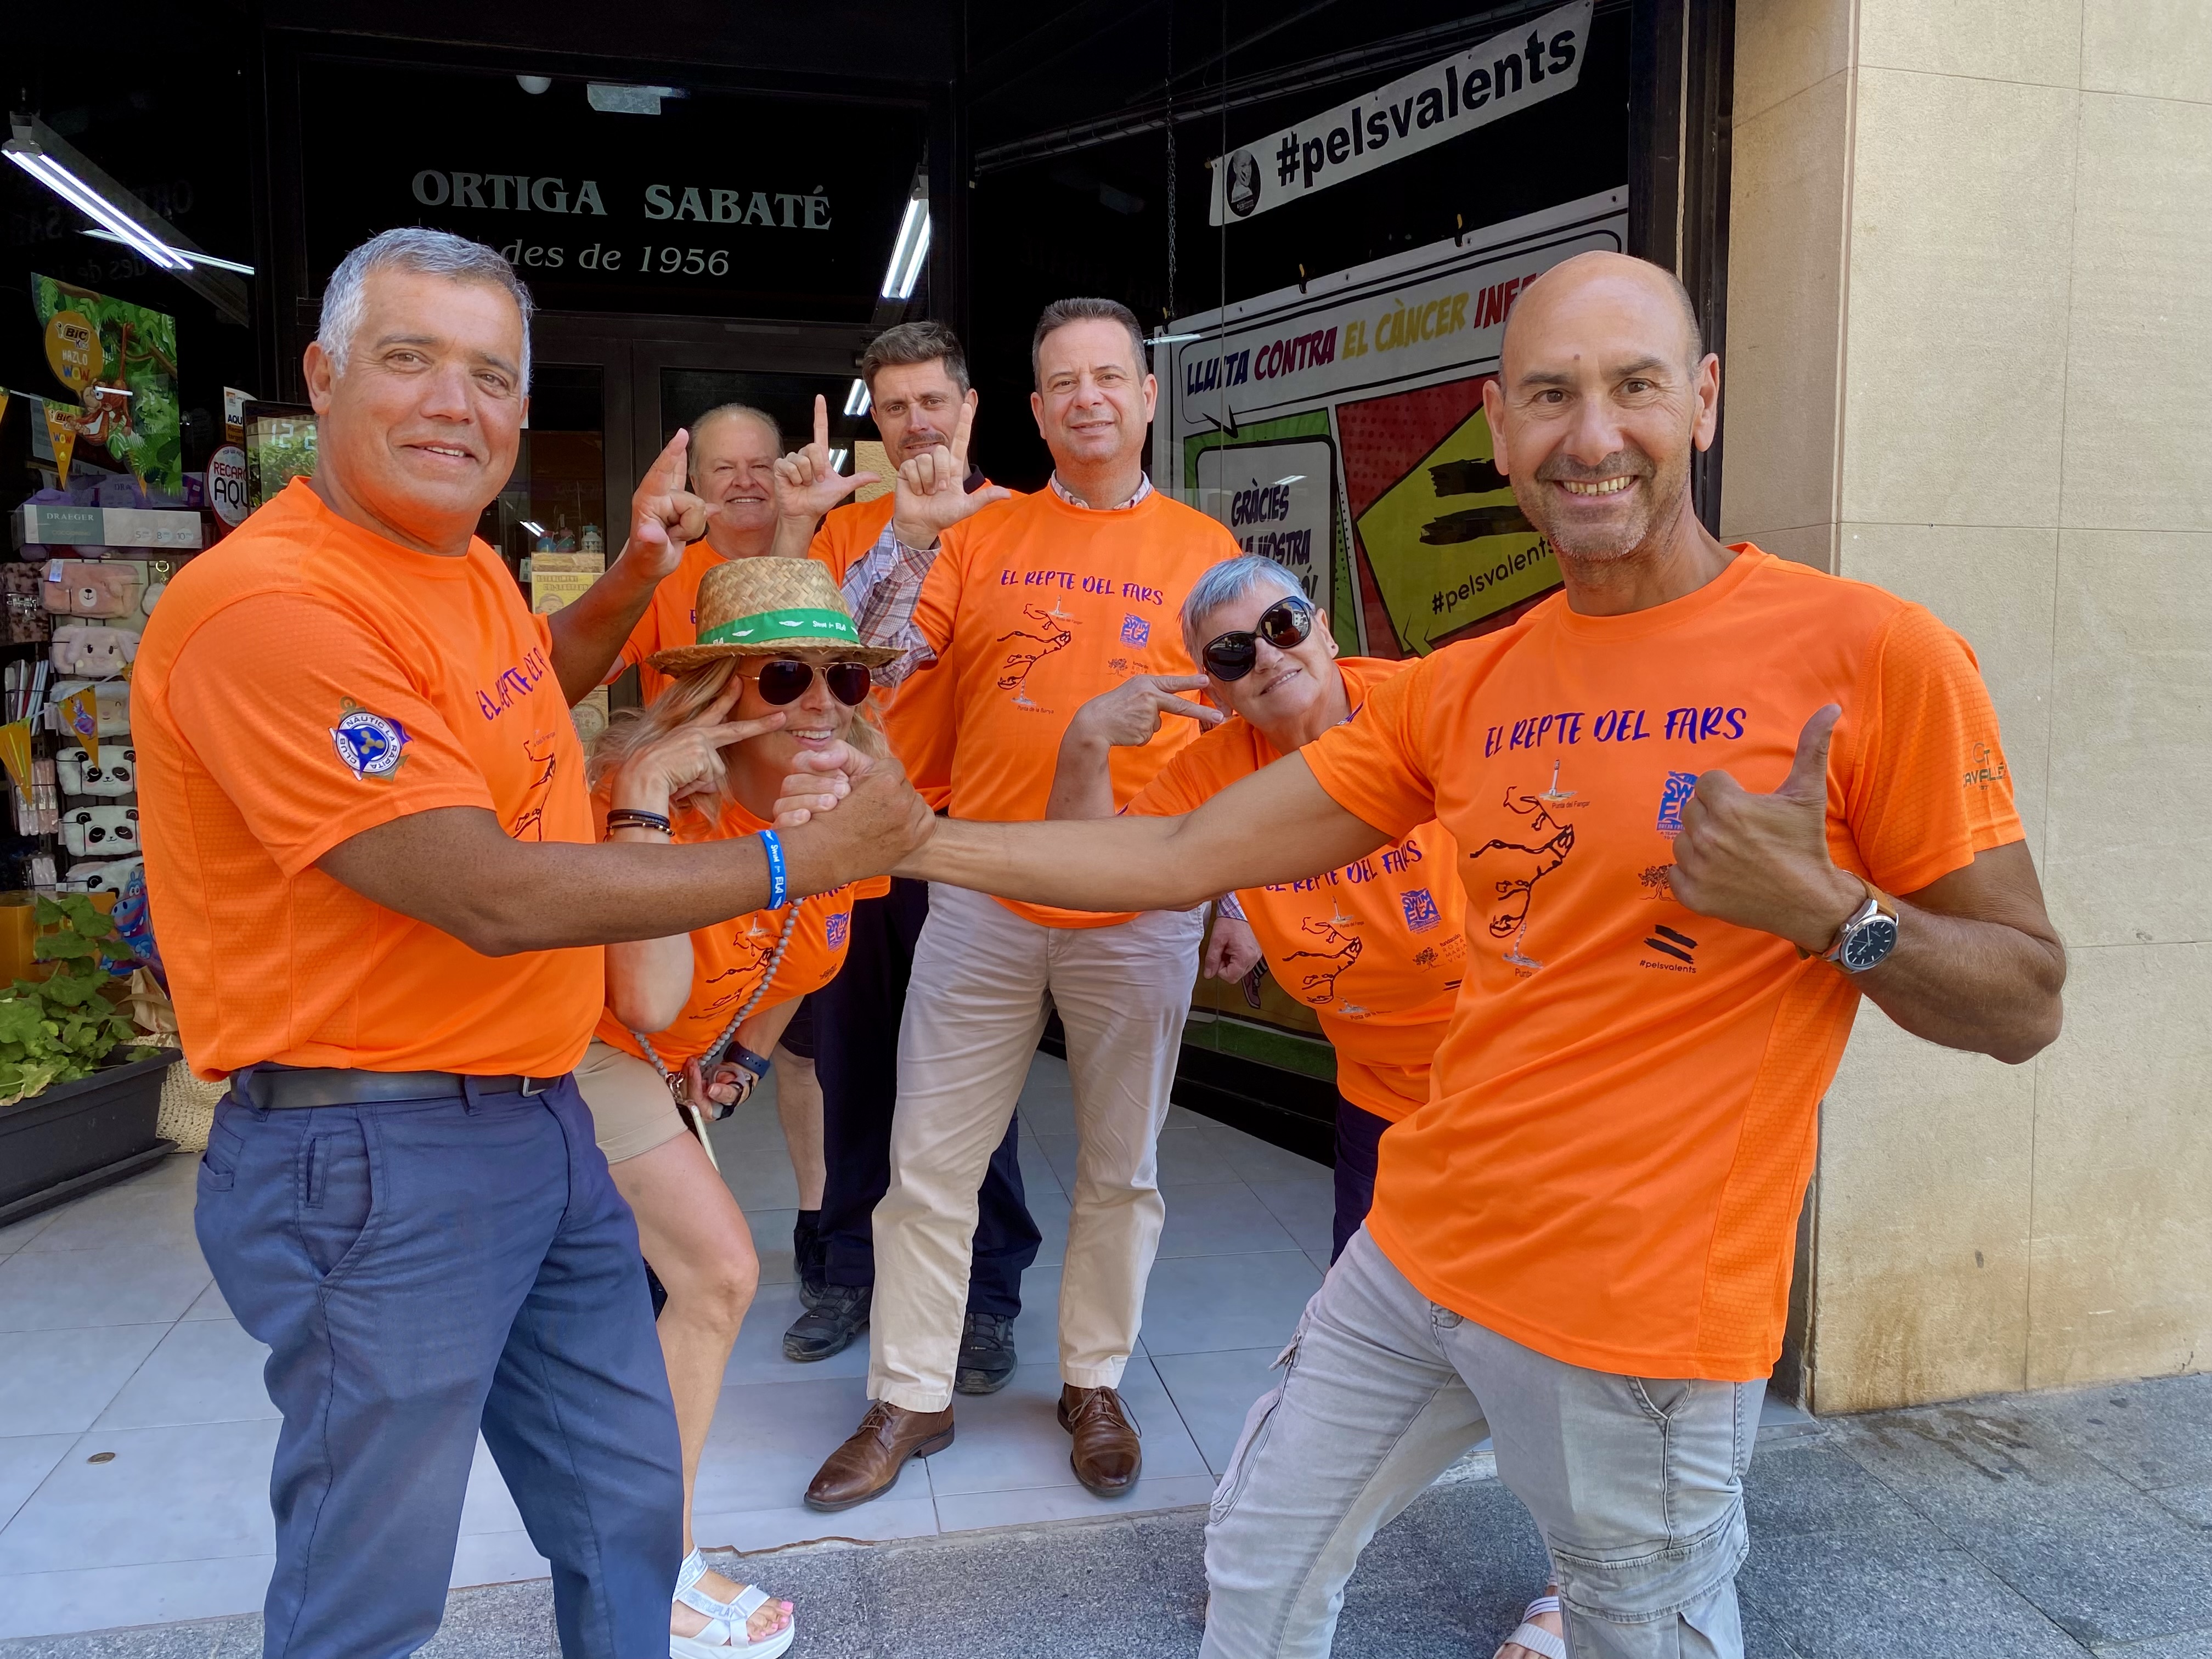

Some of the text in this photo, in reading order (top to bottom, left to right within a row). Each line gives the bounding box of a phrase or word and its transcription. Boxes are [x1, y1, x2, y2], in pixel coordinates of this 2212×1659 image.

[1276, 29, 1576, 189] #pelsvalents
[412, 170, 832, 230] ORTIGA SABATÉ
[501, 239, 729, 275] des de 1956
[63, 349, 88, 365] HAZLO
[1187, 348, 1250, 397] LLUITA
[1254, 326, 1338, 380] CONTRA
[1342, 319, 1368, 359] EL
[1375, 297, 1469, 352] CÀNCER
[63, 364, 90, 381] WOW
[228, 414, 242, 425] AQU
[54, 432, 72, 444] WOW
[215, 477, 250, 510] AQU
[1232, 477, 1289, 527] GRÀCIES
[47, 512, 94, 522] DRAEGER
[177, 532, 185, 540] 10
[1001, 569, 1163, 606] EL REPTE DEL FARS
[1485, 706, 1747, 758] EL REPTE DEL FARS
[340, 737, 357, 765] CLUB
[385, 730, 396, 742] LA
[1662, 778, 1695, 798] SW
[770, 844, 780, 862] SWIM
[775, 877, 784, 894] ELA
[1346, 857, 1378, 884] DEL
[1381, 839, 1423, 874] FARS
[1402, 893, 1431, 909] SWIM
[1443, 938, 1464, 952] ROSA
[1448, 950, 1468, 963] VIVA
[1639, 960, 1697, 973] #pelsvalents
